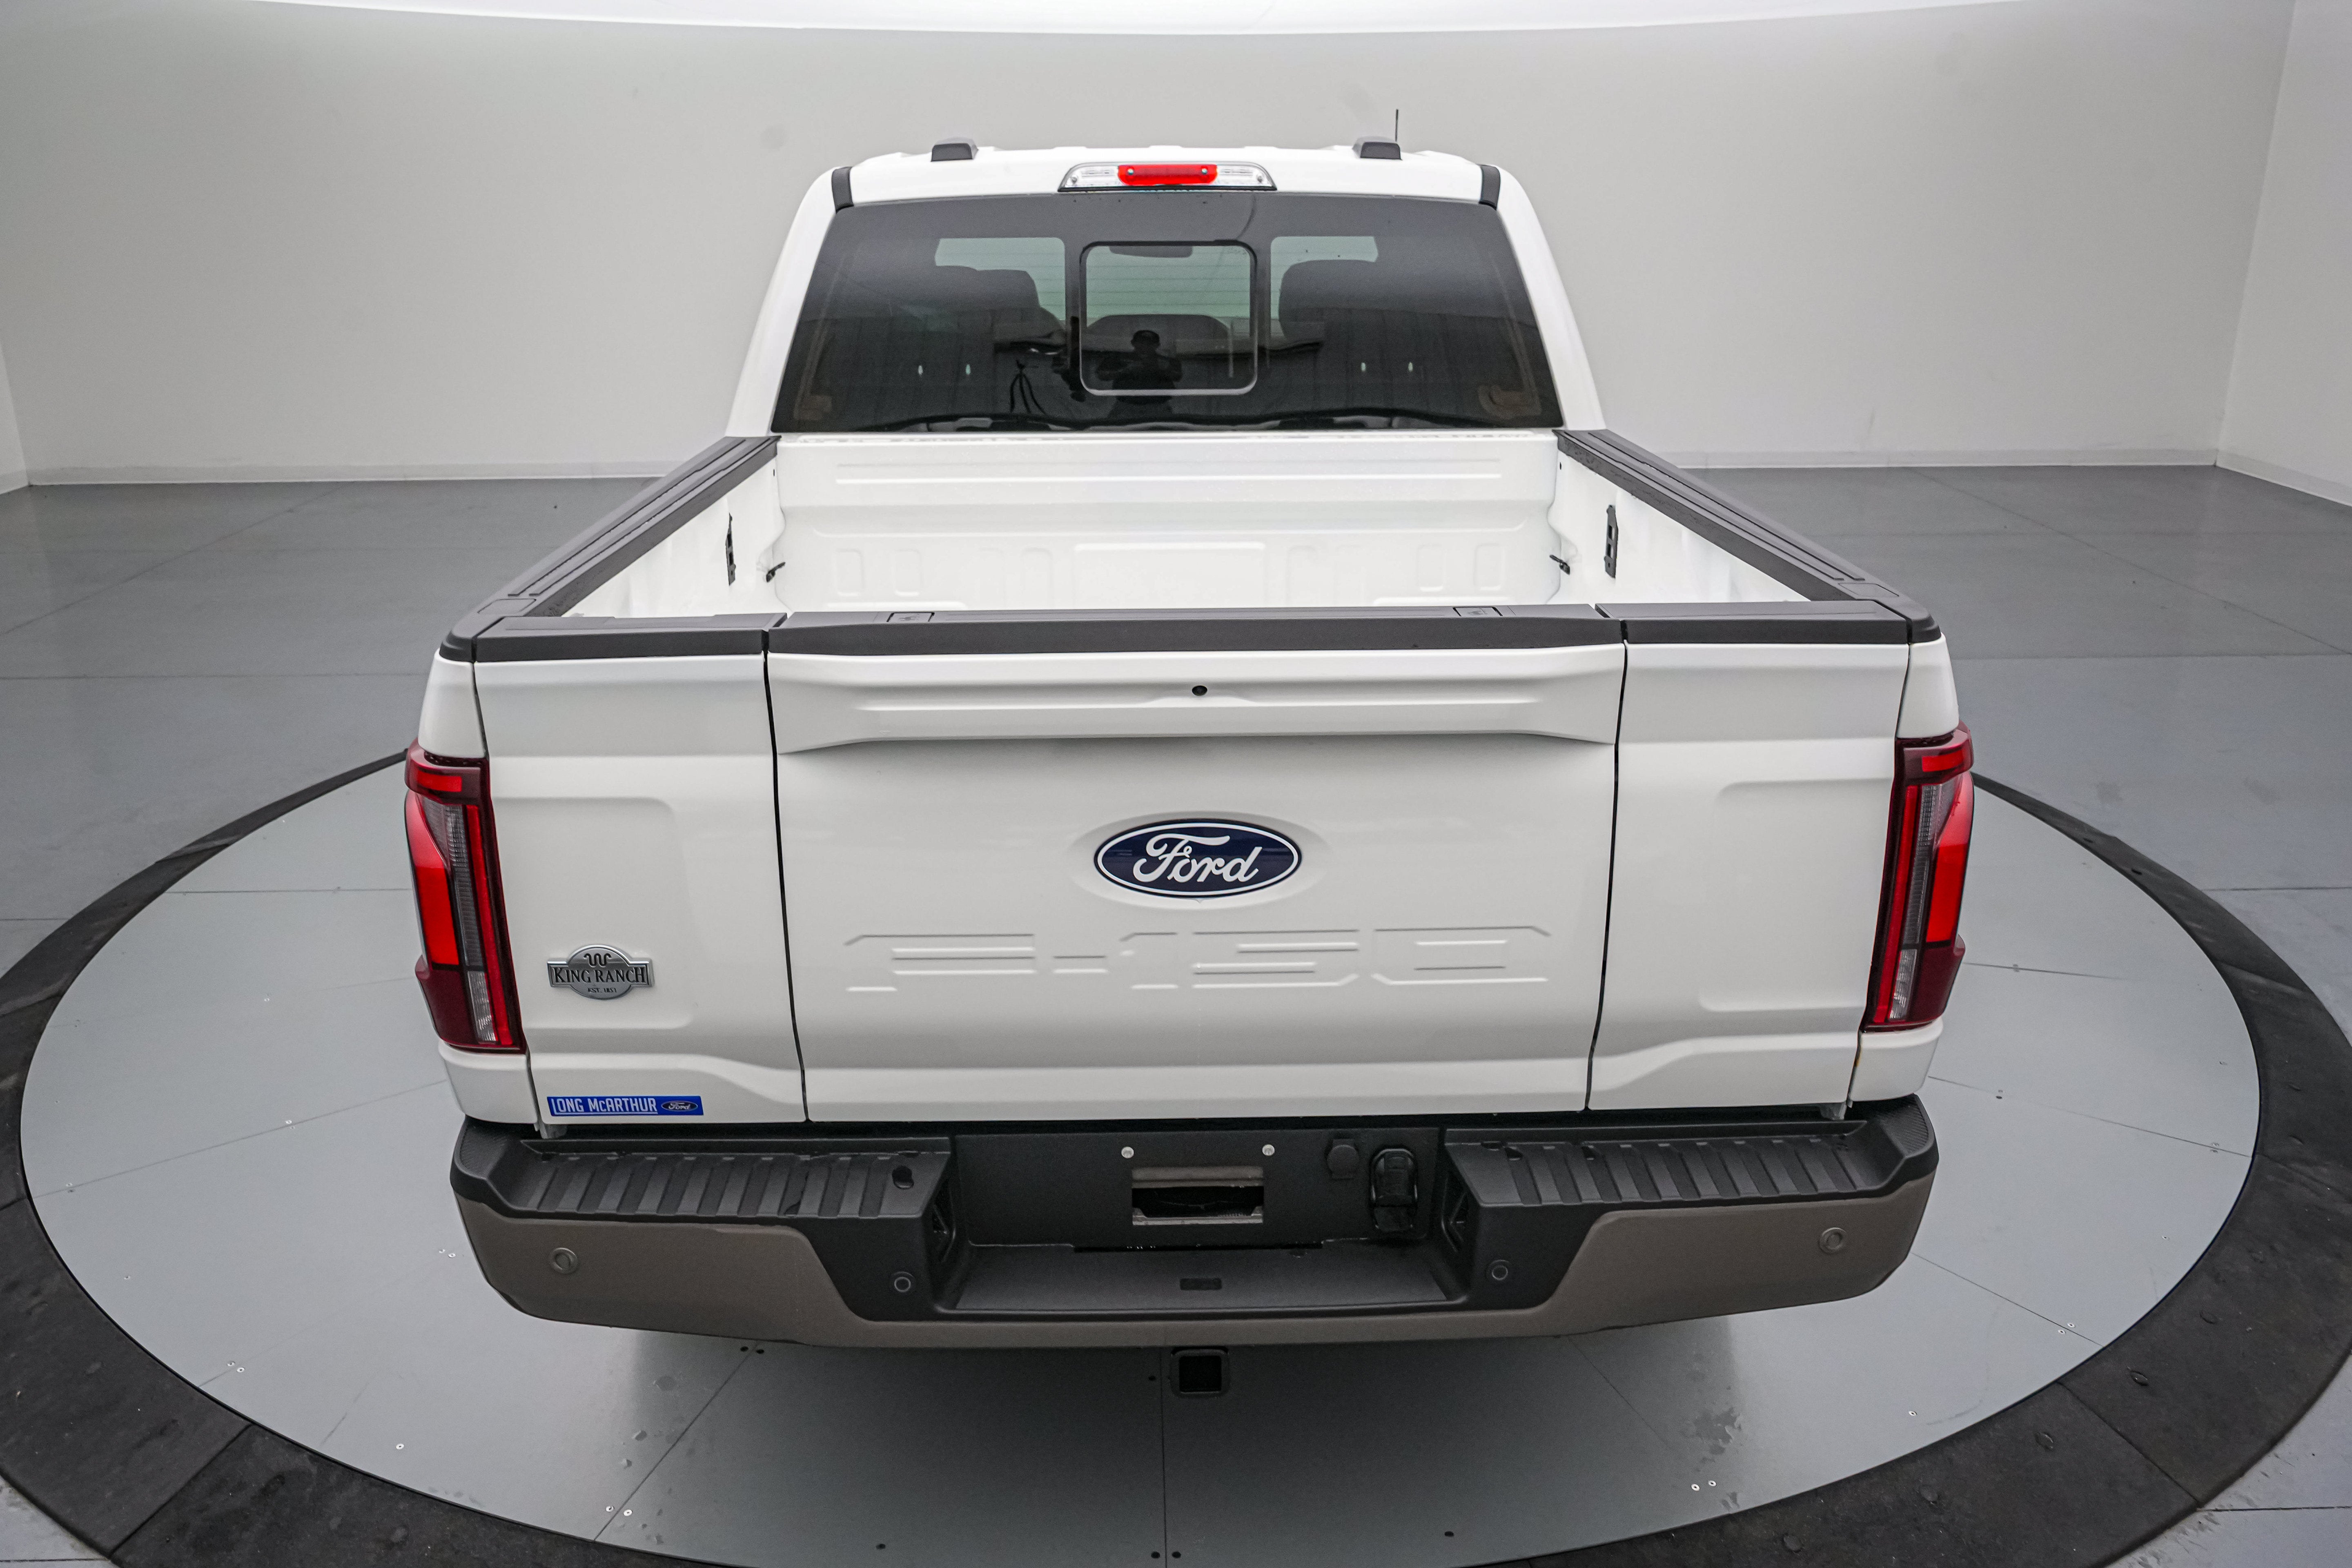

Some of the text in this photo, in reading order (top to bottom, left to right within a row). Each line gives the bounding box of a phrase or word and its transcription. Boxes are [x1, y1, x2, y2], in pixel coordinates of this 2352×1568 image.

[1133, 833, 1263, 882] Ford
[554, 966, 645, 983] KING RANCH
[551, 1098, 691, 1114] LONG McARTHUR Ford
